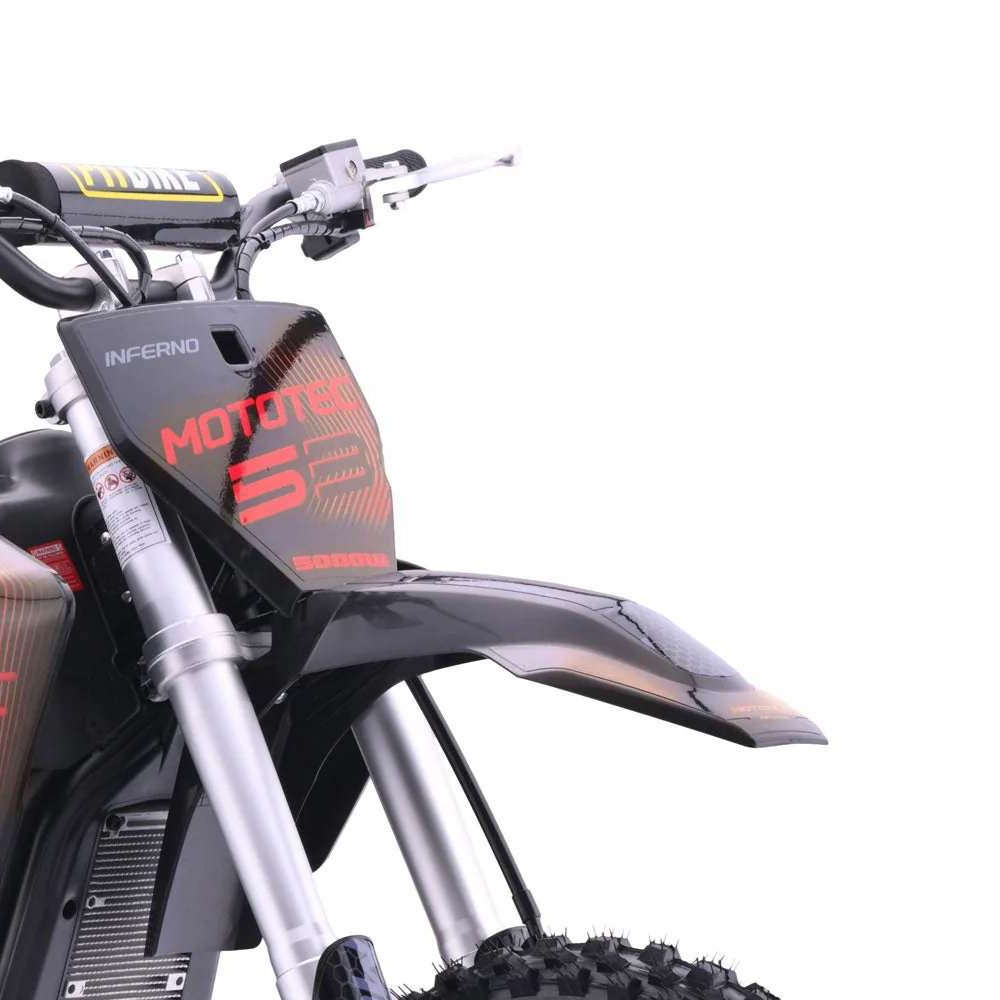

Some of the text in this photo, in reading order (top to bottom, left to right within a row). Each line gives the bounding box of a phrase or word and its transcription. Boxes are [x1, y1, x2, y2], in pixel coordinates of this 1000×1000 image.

[105, 338, 199, 367] INFERNO
[160, 376, 361, 465] MOTOTEC
[293, 552, 389, 571] 5000W
